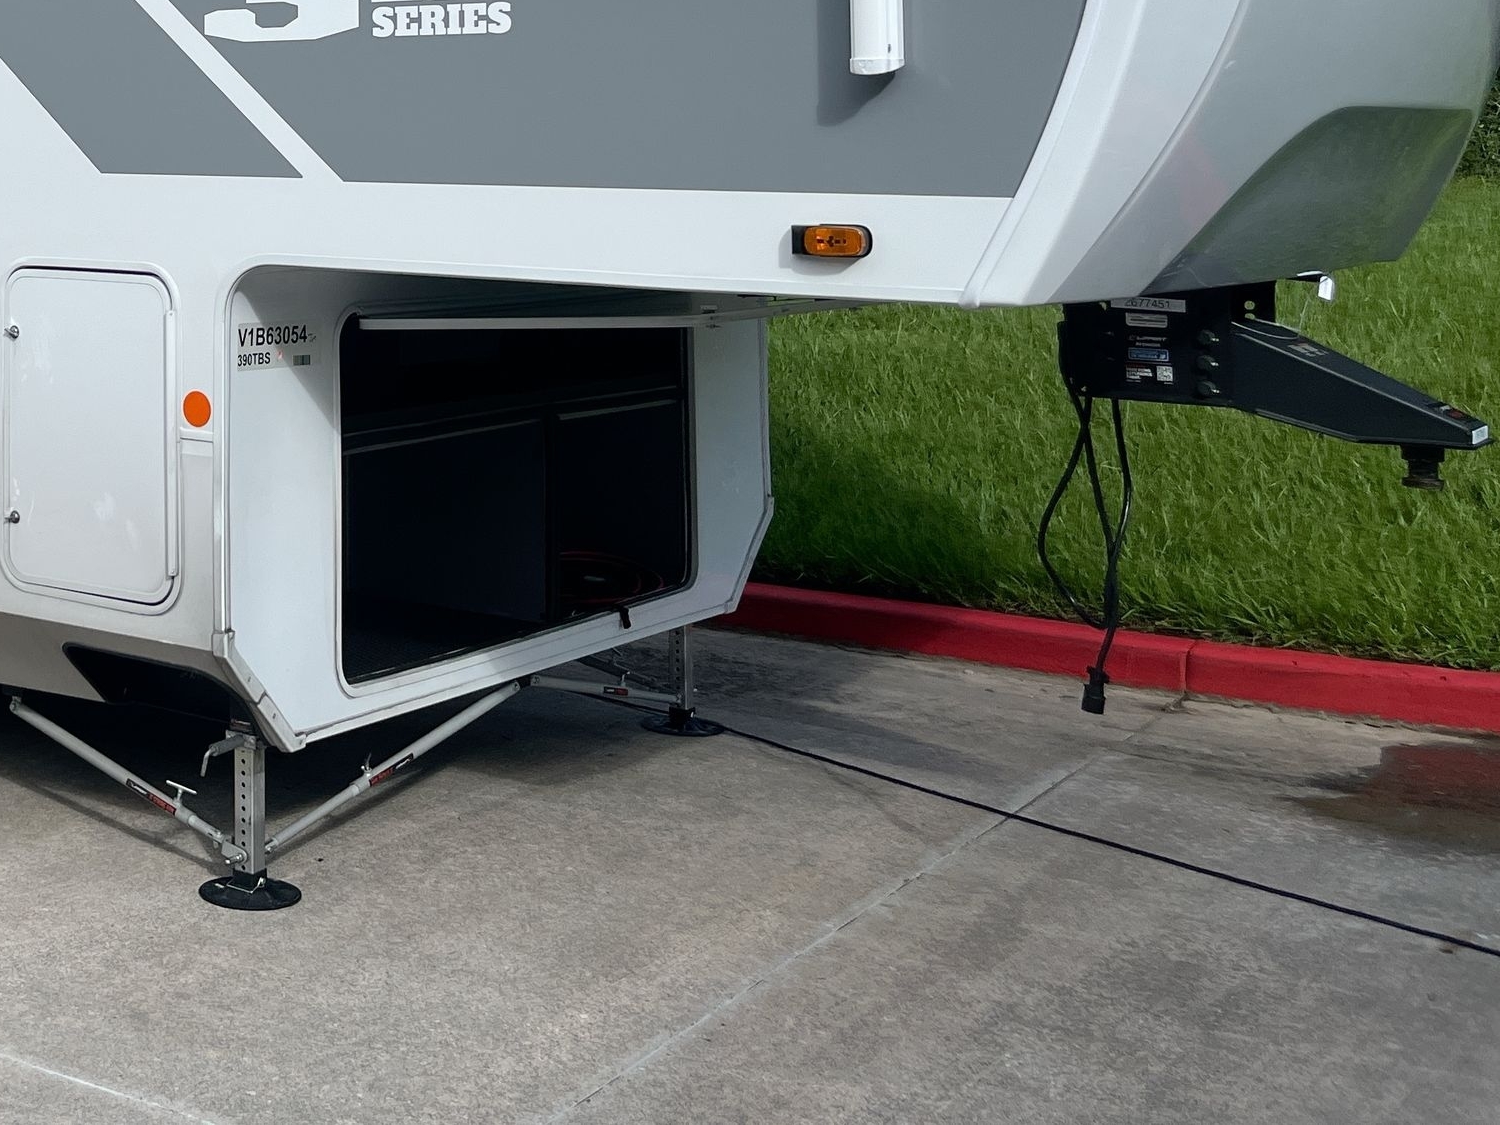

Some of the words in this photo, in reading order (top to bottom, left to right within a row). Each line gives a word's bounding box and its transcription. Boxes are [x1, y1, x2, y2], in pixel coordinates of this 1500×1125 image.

[372, 1, 512, 38] SERIES
[238, 324, 308, 347] V1B63054
[237, 352, 271, 367] 390TBS
